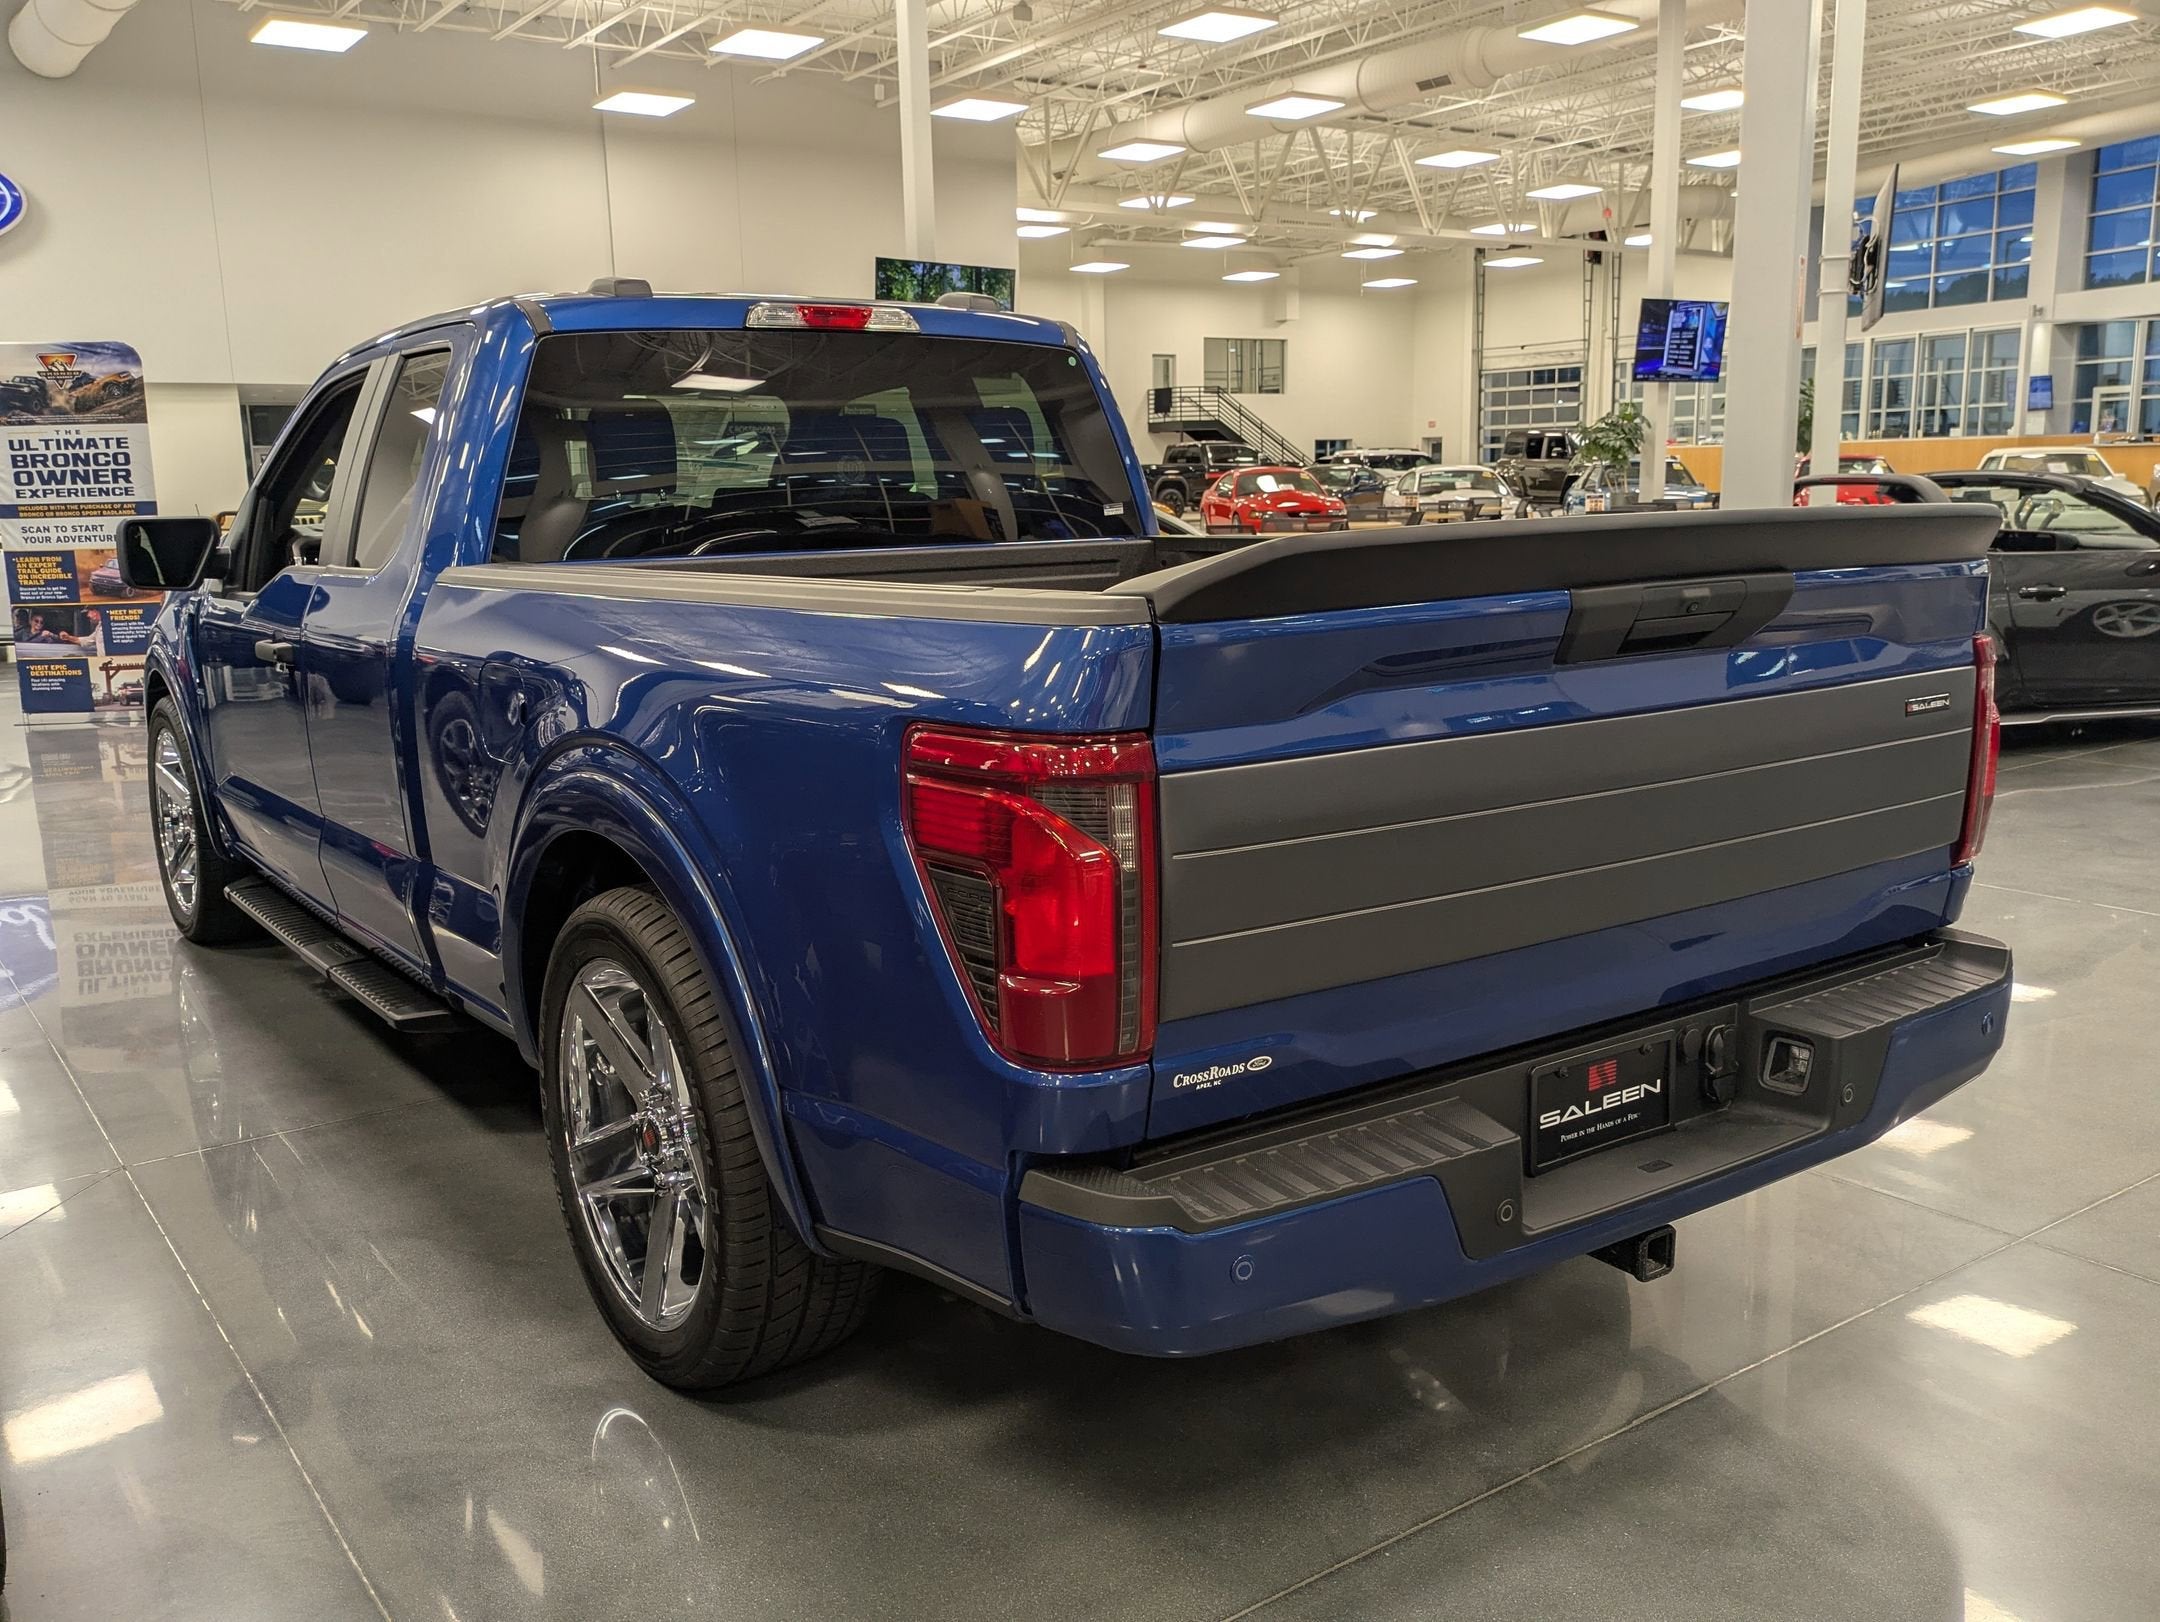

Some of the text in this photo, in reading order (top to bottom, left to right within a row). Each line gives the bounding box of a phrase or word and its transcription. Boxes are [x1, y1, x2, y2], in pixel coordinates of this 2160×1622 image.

[8, 437, 129, 452] ULTIMATE
[10, 452, 131, 469] BRONCO
[13, 468, 133, 486] OWNER
[15, 486, 135, 499] EXPERIENCE
[21, 524, 104, 534] SCAN TO START
[22, 536, 52, 544] YOUR
[1912, 698, 1950, 711] SALEEN
[1196, 1082, 1212, 1090] APEX,
[1539, 1079, 1661, 1129] SALEEN
